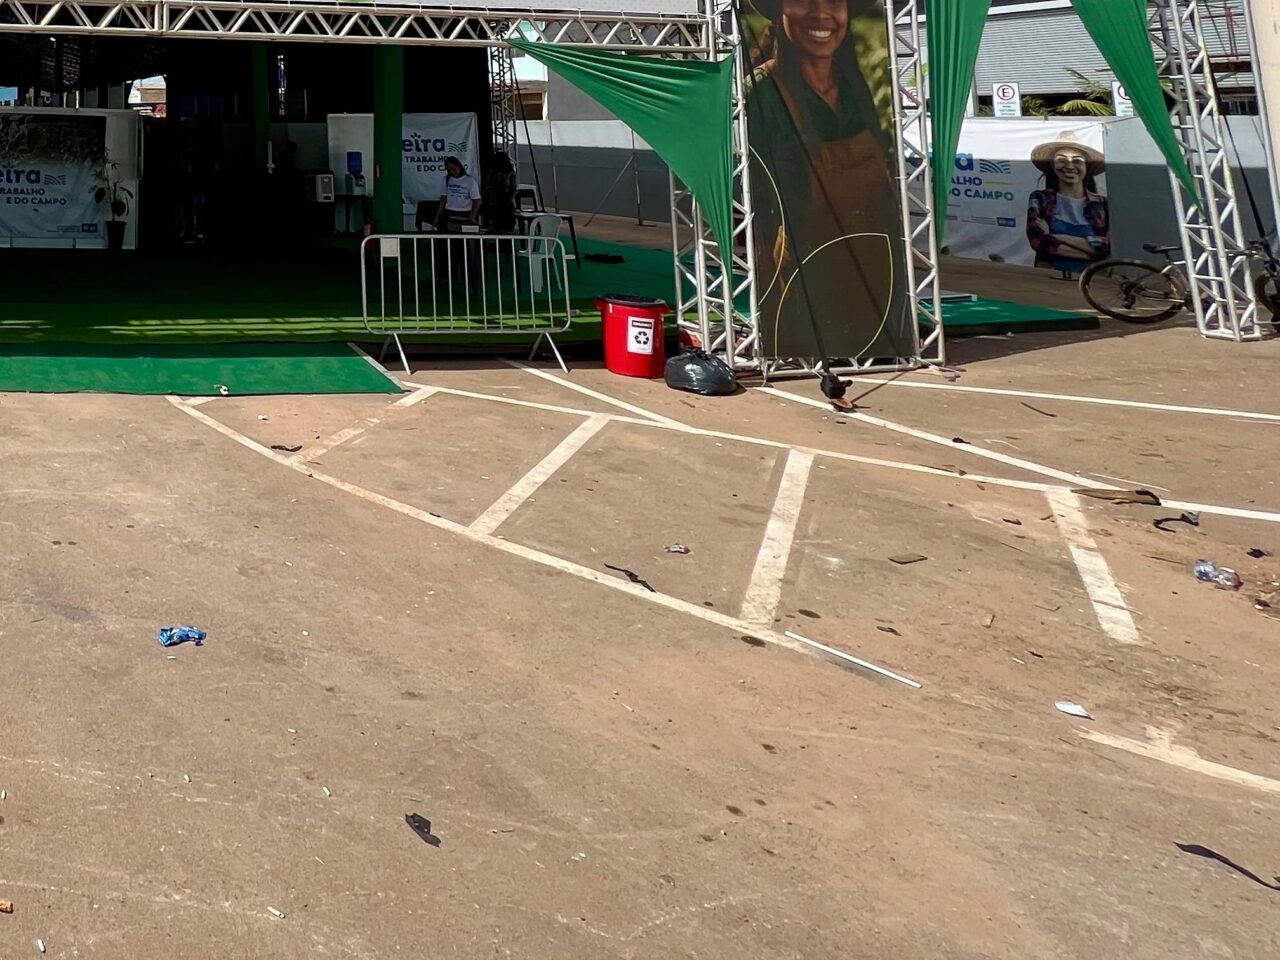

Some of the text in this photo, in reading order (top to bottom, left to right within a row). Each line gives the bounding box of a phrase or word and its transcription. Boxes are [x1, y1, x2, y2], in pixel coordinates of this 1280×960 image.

[401, 133, 445, 152] eira
[423, 164, 437, 172] DO
[964, 188, 1015, 201] CAMPO
[30, 197, 67, 205] CAMPO
